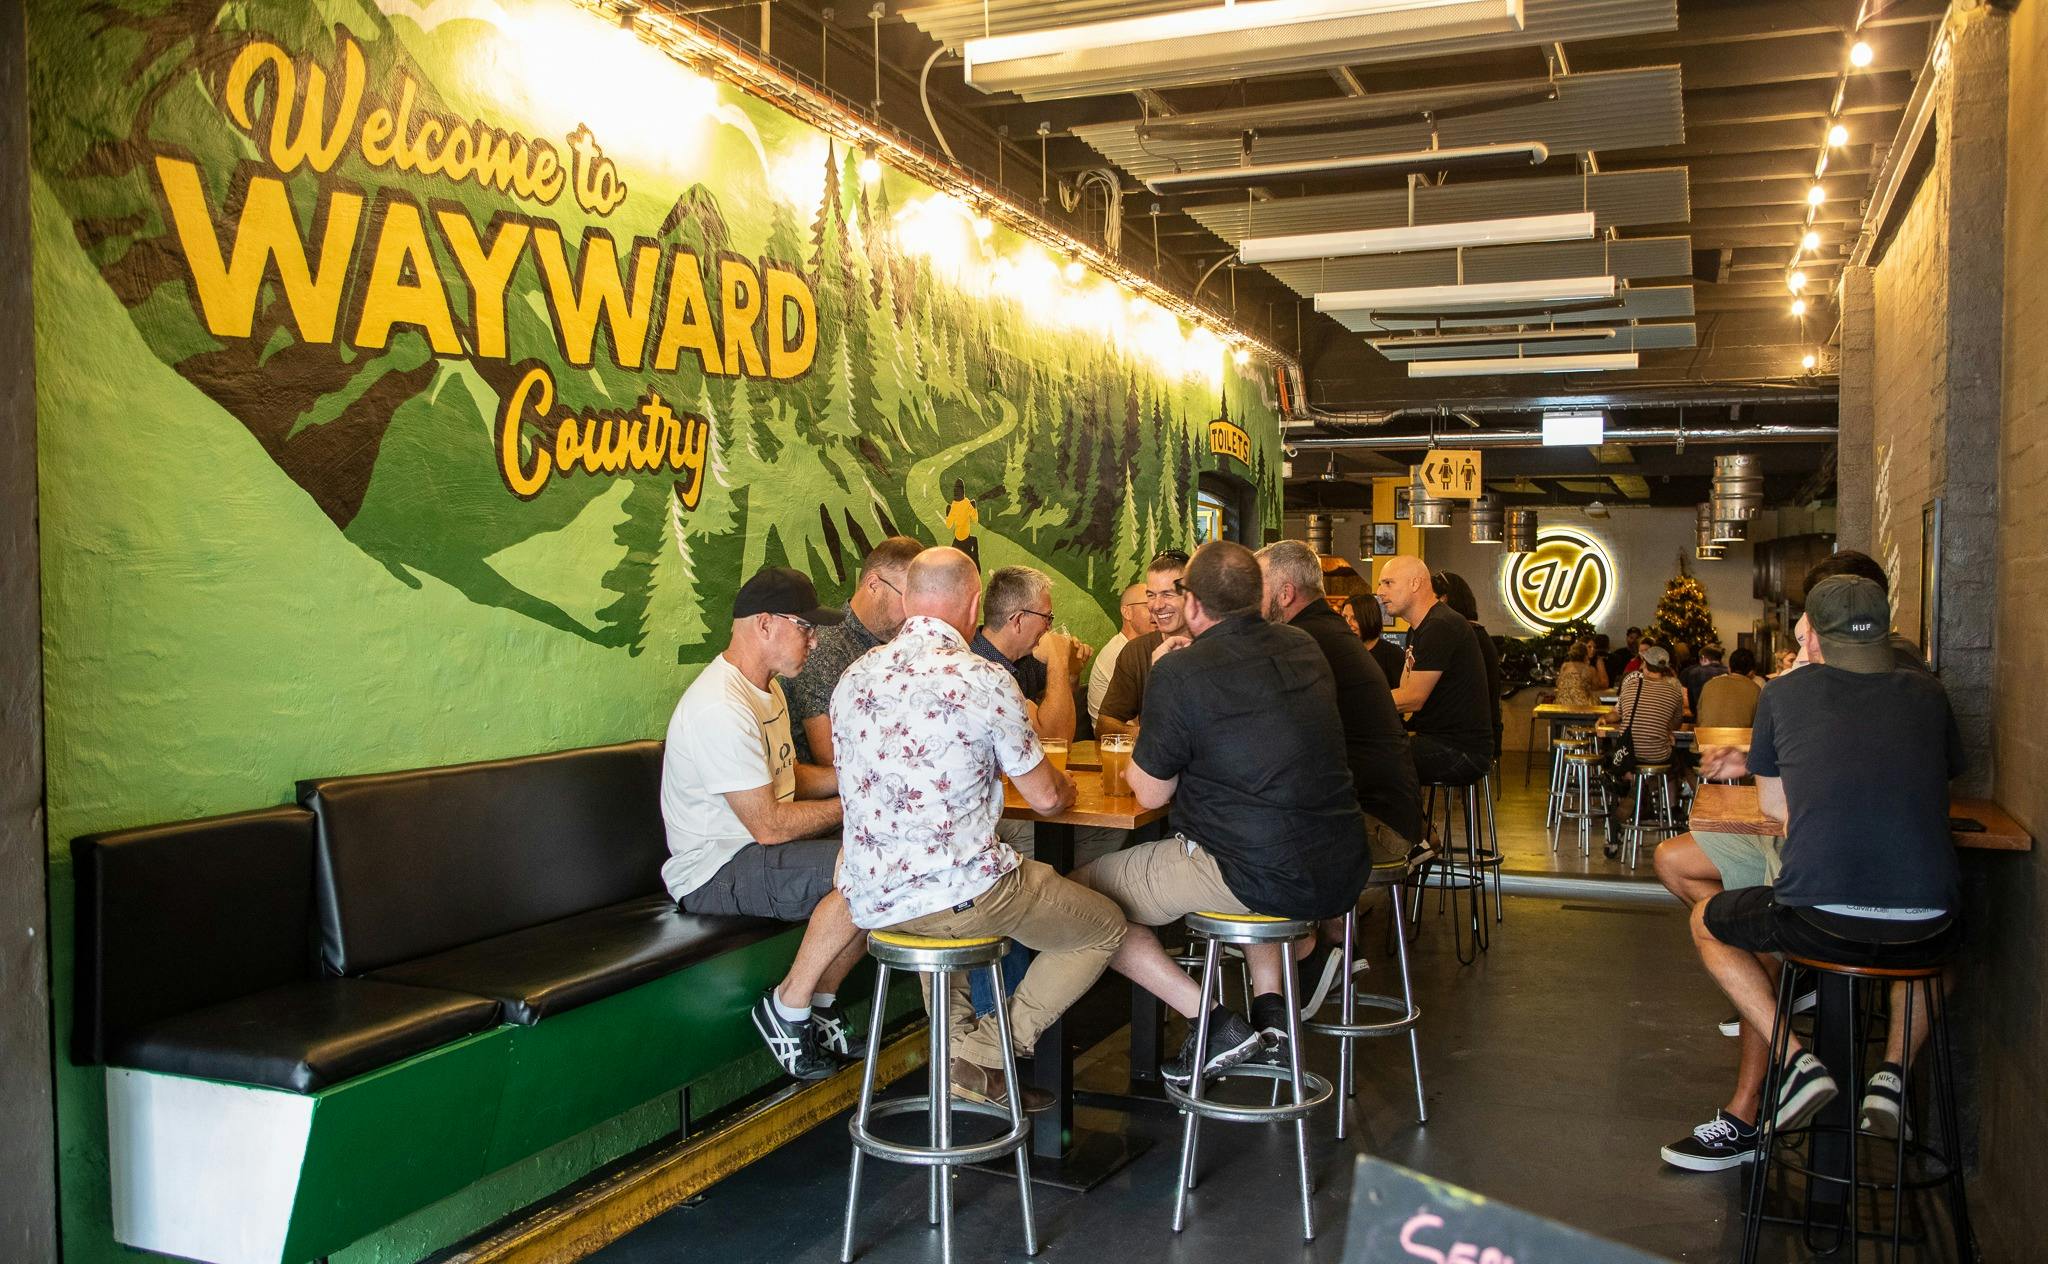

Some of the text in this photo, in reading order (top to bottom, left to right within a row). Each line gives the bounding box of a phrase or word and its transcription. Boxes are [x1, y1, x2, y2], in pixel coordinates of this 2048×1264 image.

[226, 38, 625, 215] Welcome to
[155, 155, 818, 380] WAYWARD
[502, 367, 708, 508] Country
[1211, 428, 1249, 463] TOILETS
[1852, 623, 1871, 632] HUF
[1877, 1074, 1897, 1086] NIKE
